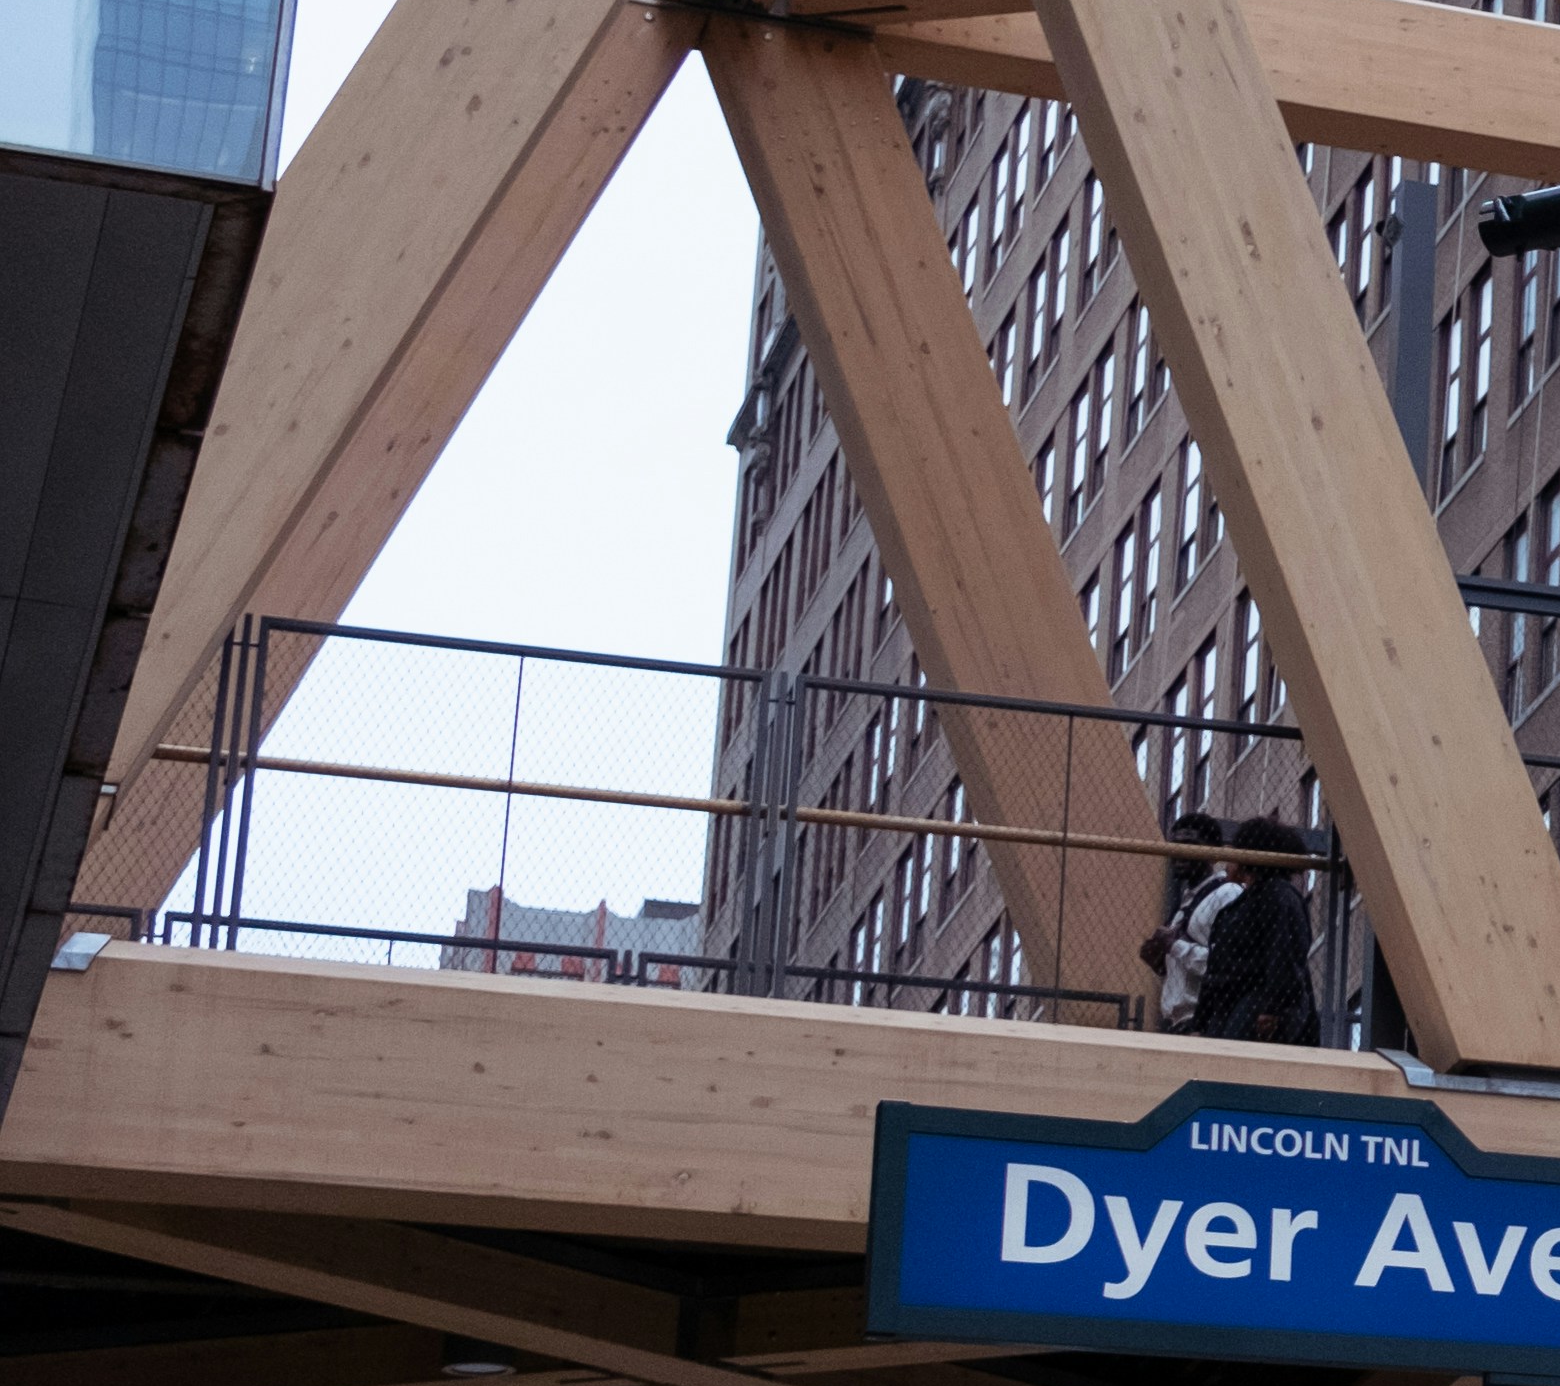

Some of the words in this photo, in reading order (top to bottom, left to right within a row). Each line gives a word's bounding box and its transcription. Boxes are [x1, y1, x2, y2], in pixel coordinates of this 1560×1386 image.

[1191, 1121, 1350, 1162] LINCOLN
[1360, 1134, 1431, 1168] TNL
[1001, 1162, 1319, 1300] Dyer
